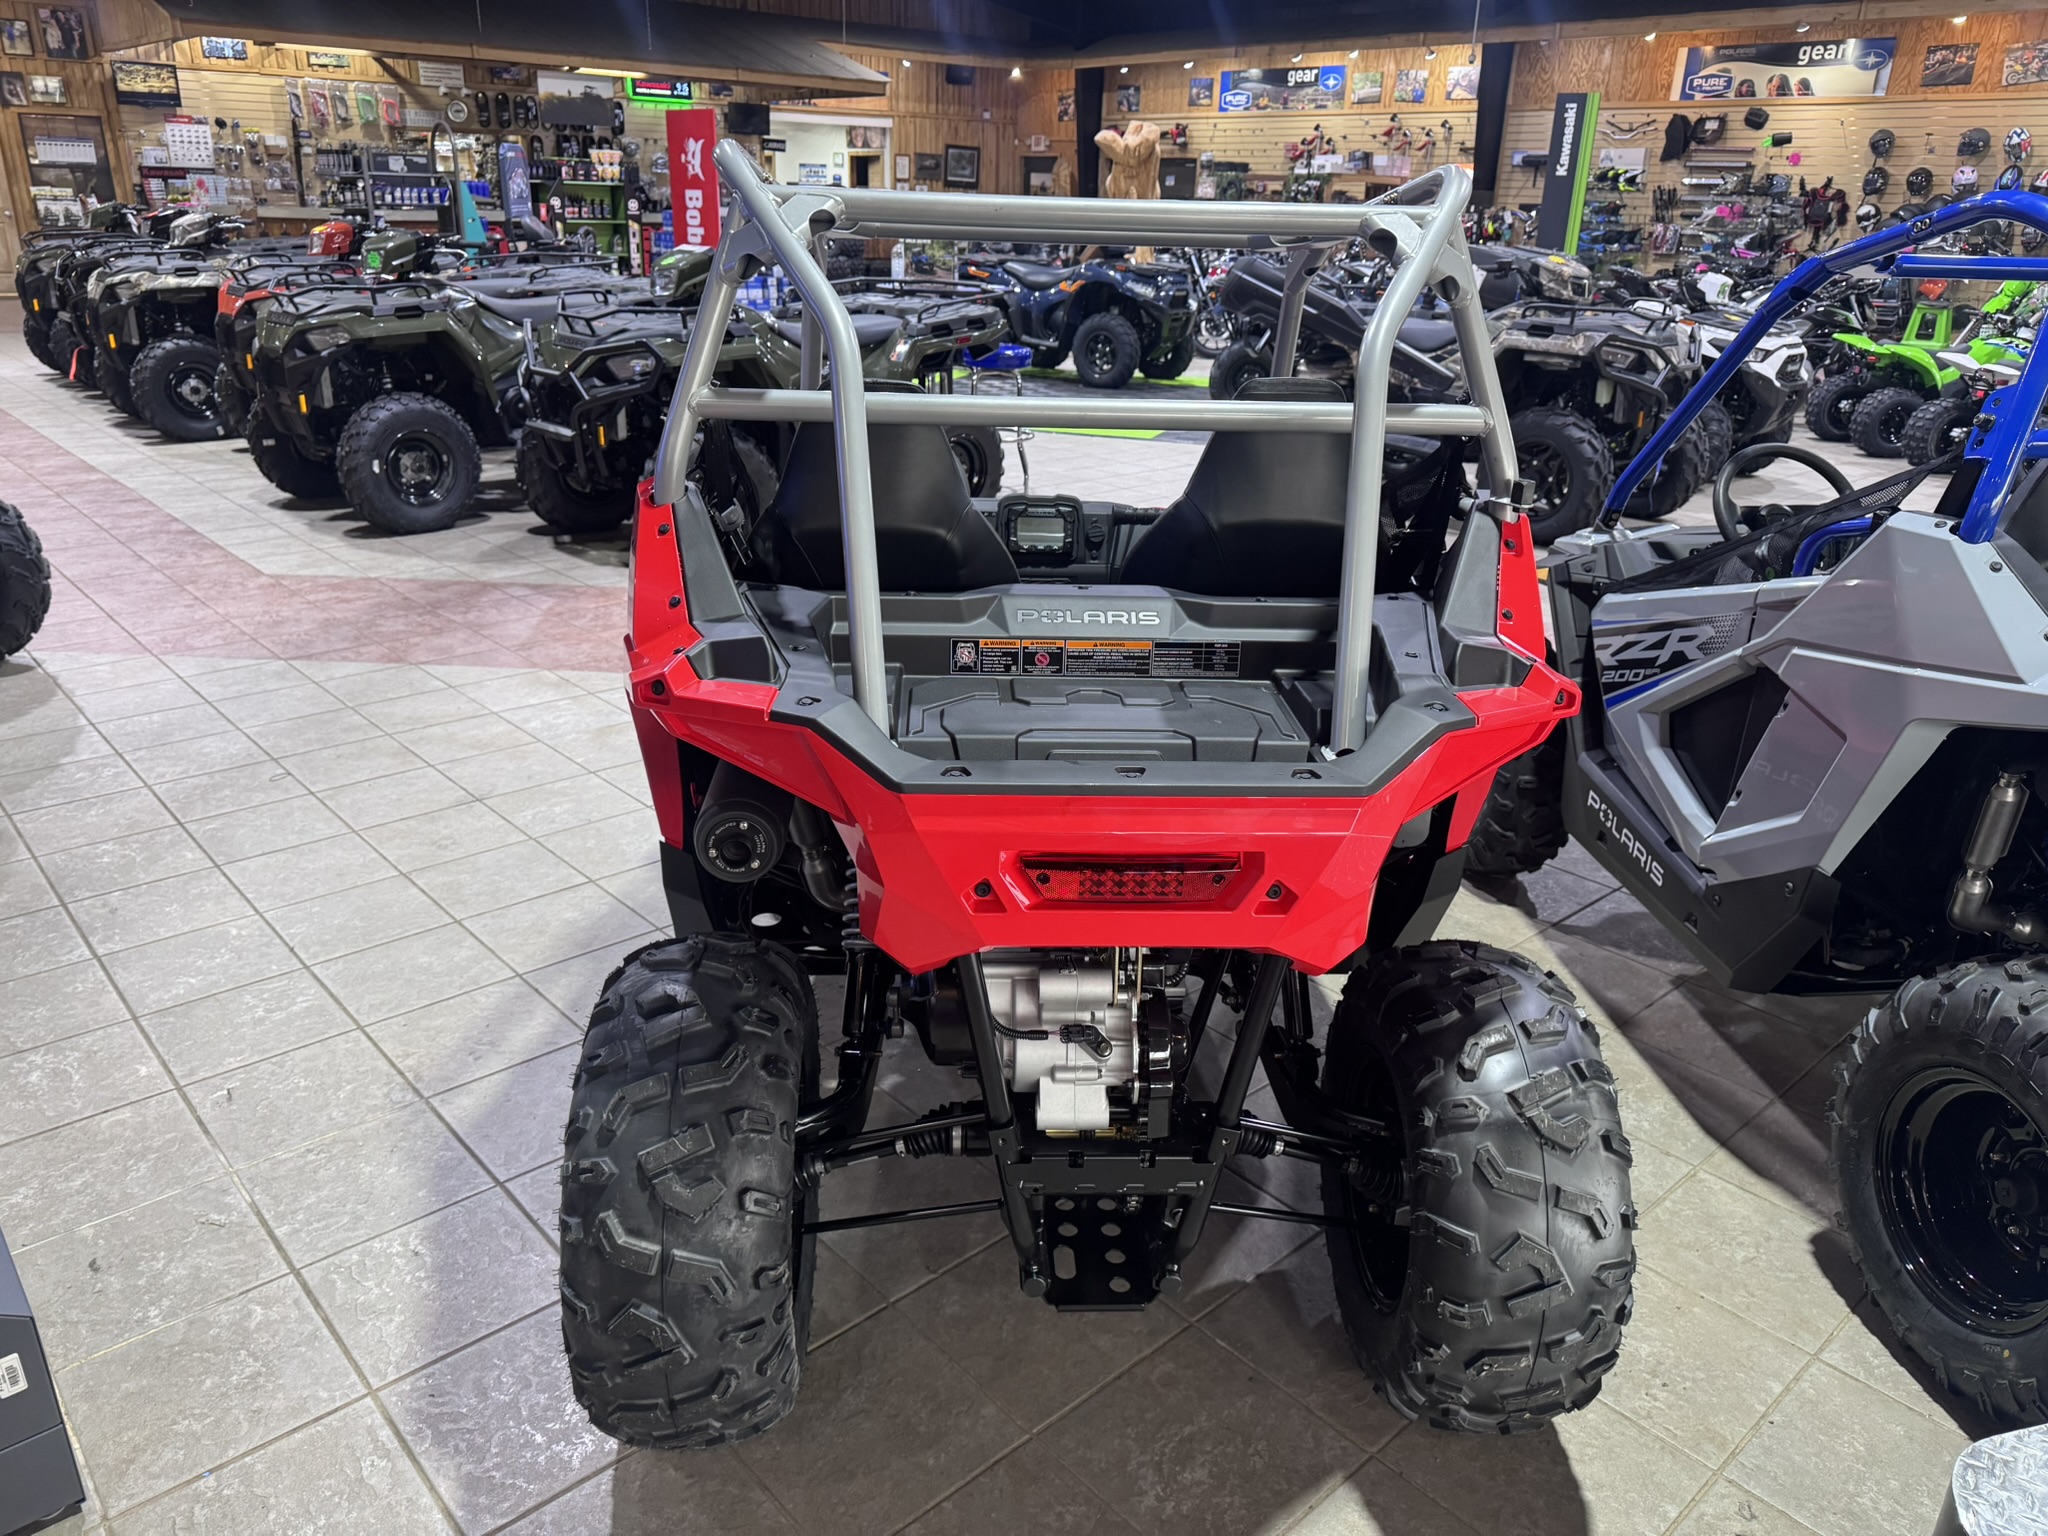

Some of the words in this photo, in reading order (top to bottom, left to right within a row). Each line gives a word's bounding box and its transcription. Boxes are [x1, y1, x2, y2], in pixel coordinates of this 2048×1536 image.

[1797, 43, 1848, 66] gear
[1287, 68, 1319, 87] gear
[1692, 77, 1728, 87] PURE
[1554, 102, 1578, 177] Kawasaki
[685, 188, 705, 244] Bob
[1016, 608, 1161, 625] POLARIS
[1595, 626, 1715, 667] RZR
[1601, 668, 1645, 683] 200
[1586, 788, 1664, 888] POLARIS
